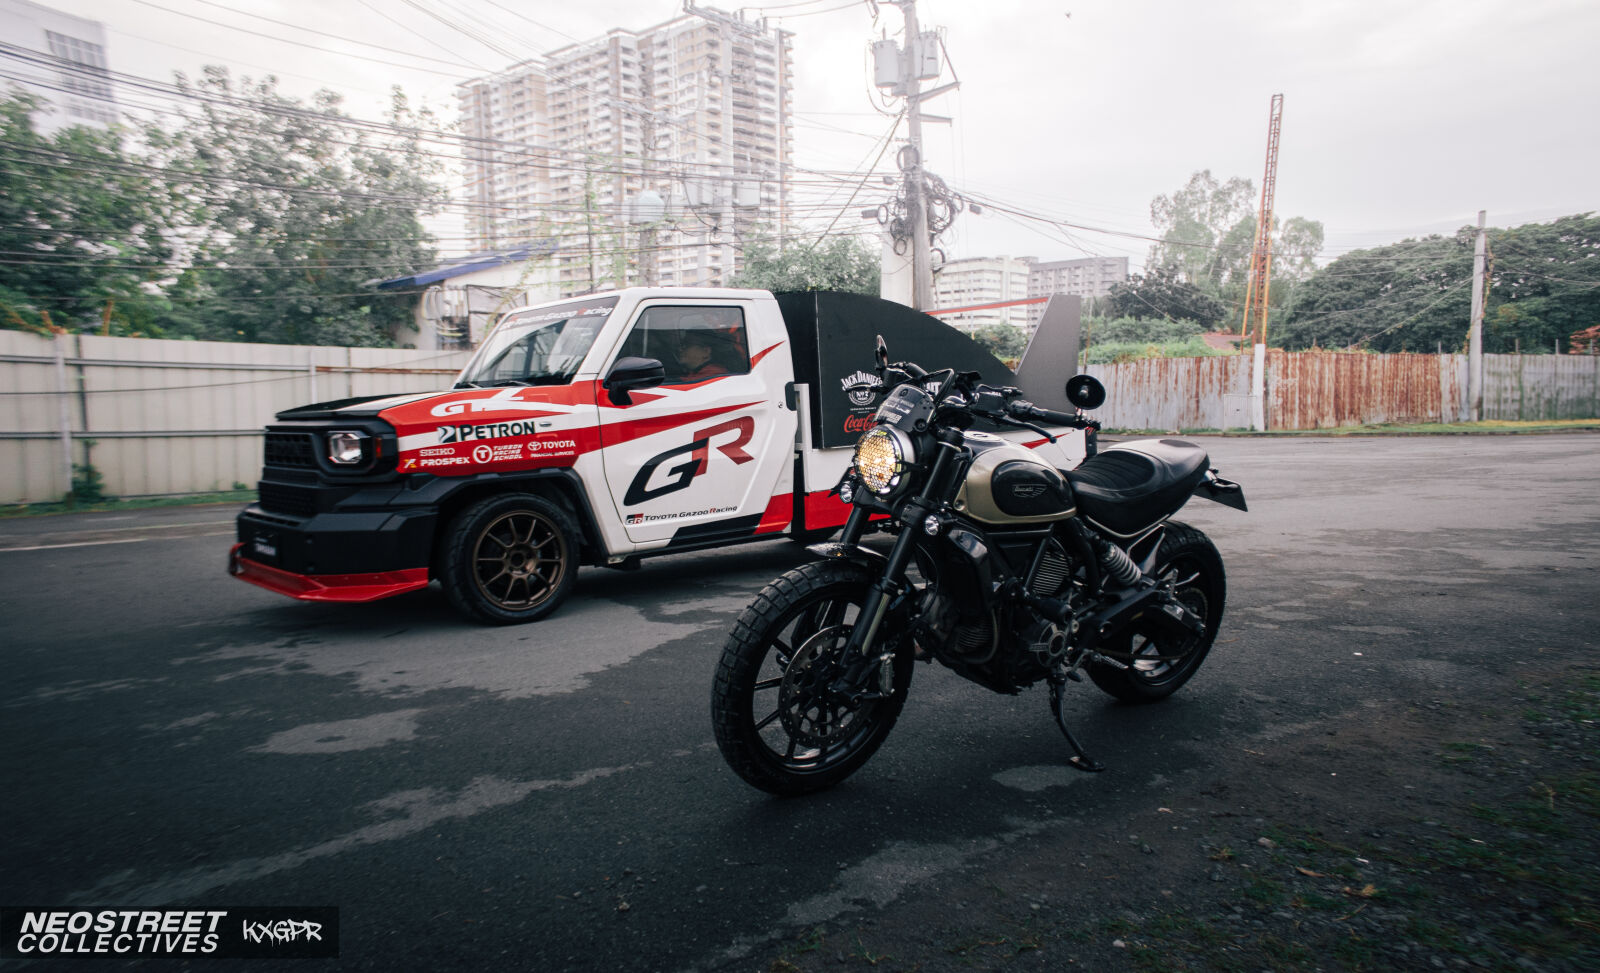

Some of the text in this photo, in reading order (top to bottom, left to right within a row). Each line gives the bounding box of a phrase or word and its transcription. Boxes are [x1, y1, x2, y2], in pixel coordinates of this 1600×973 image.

[460, 421, 535, 442] PETRON
[542, 440, 576, 449] TOYOTA
[420, 447, 455, 457] SEIKO
[420, 456, 470, 467] PROSPEX
[623, 416, 755, 506] GR
[645, 506, 738, 521] TOYOTA GAZOO Racing
